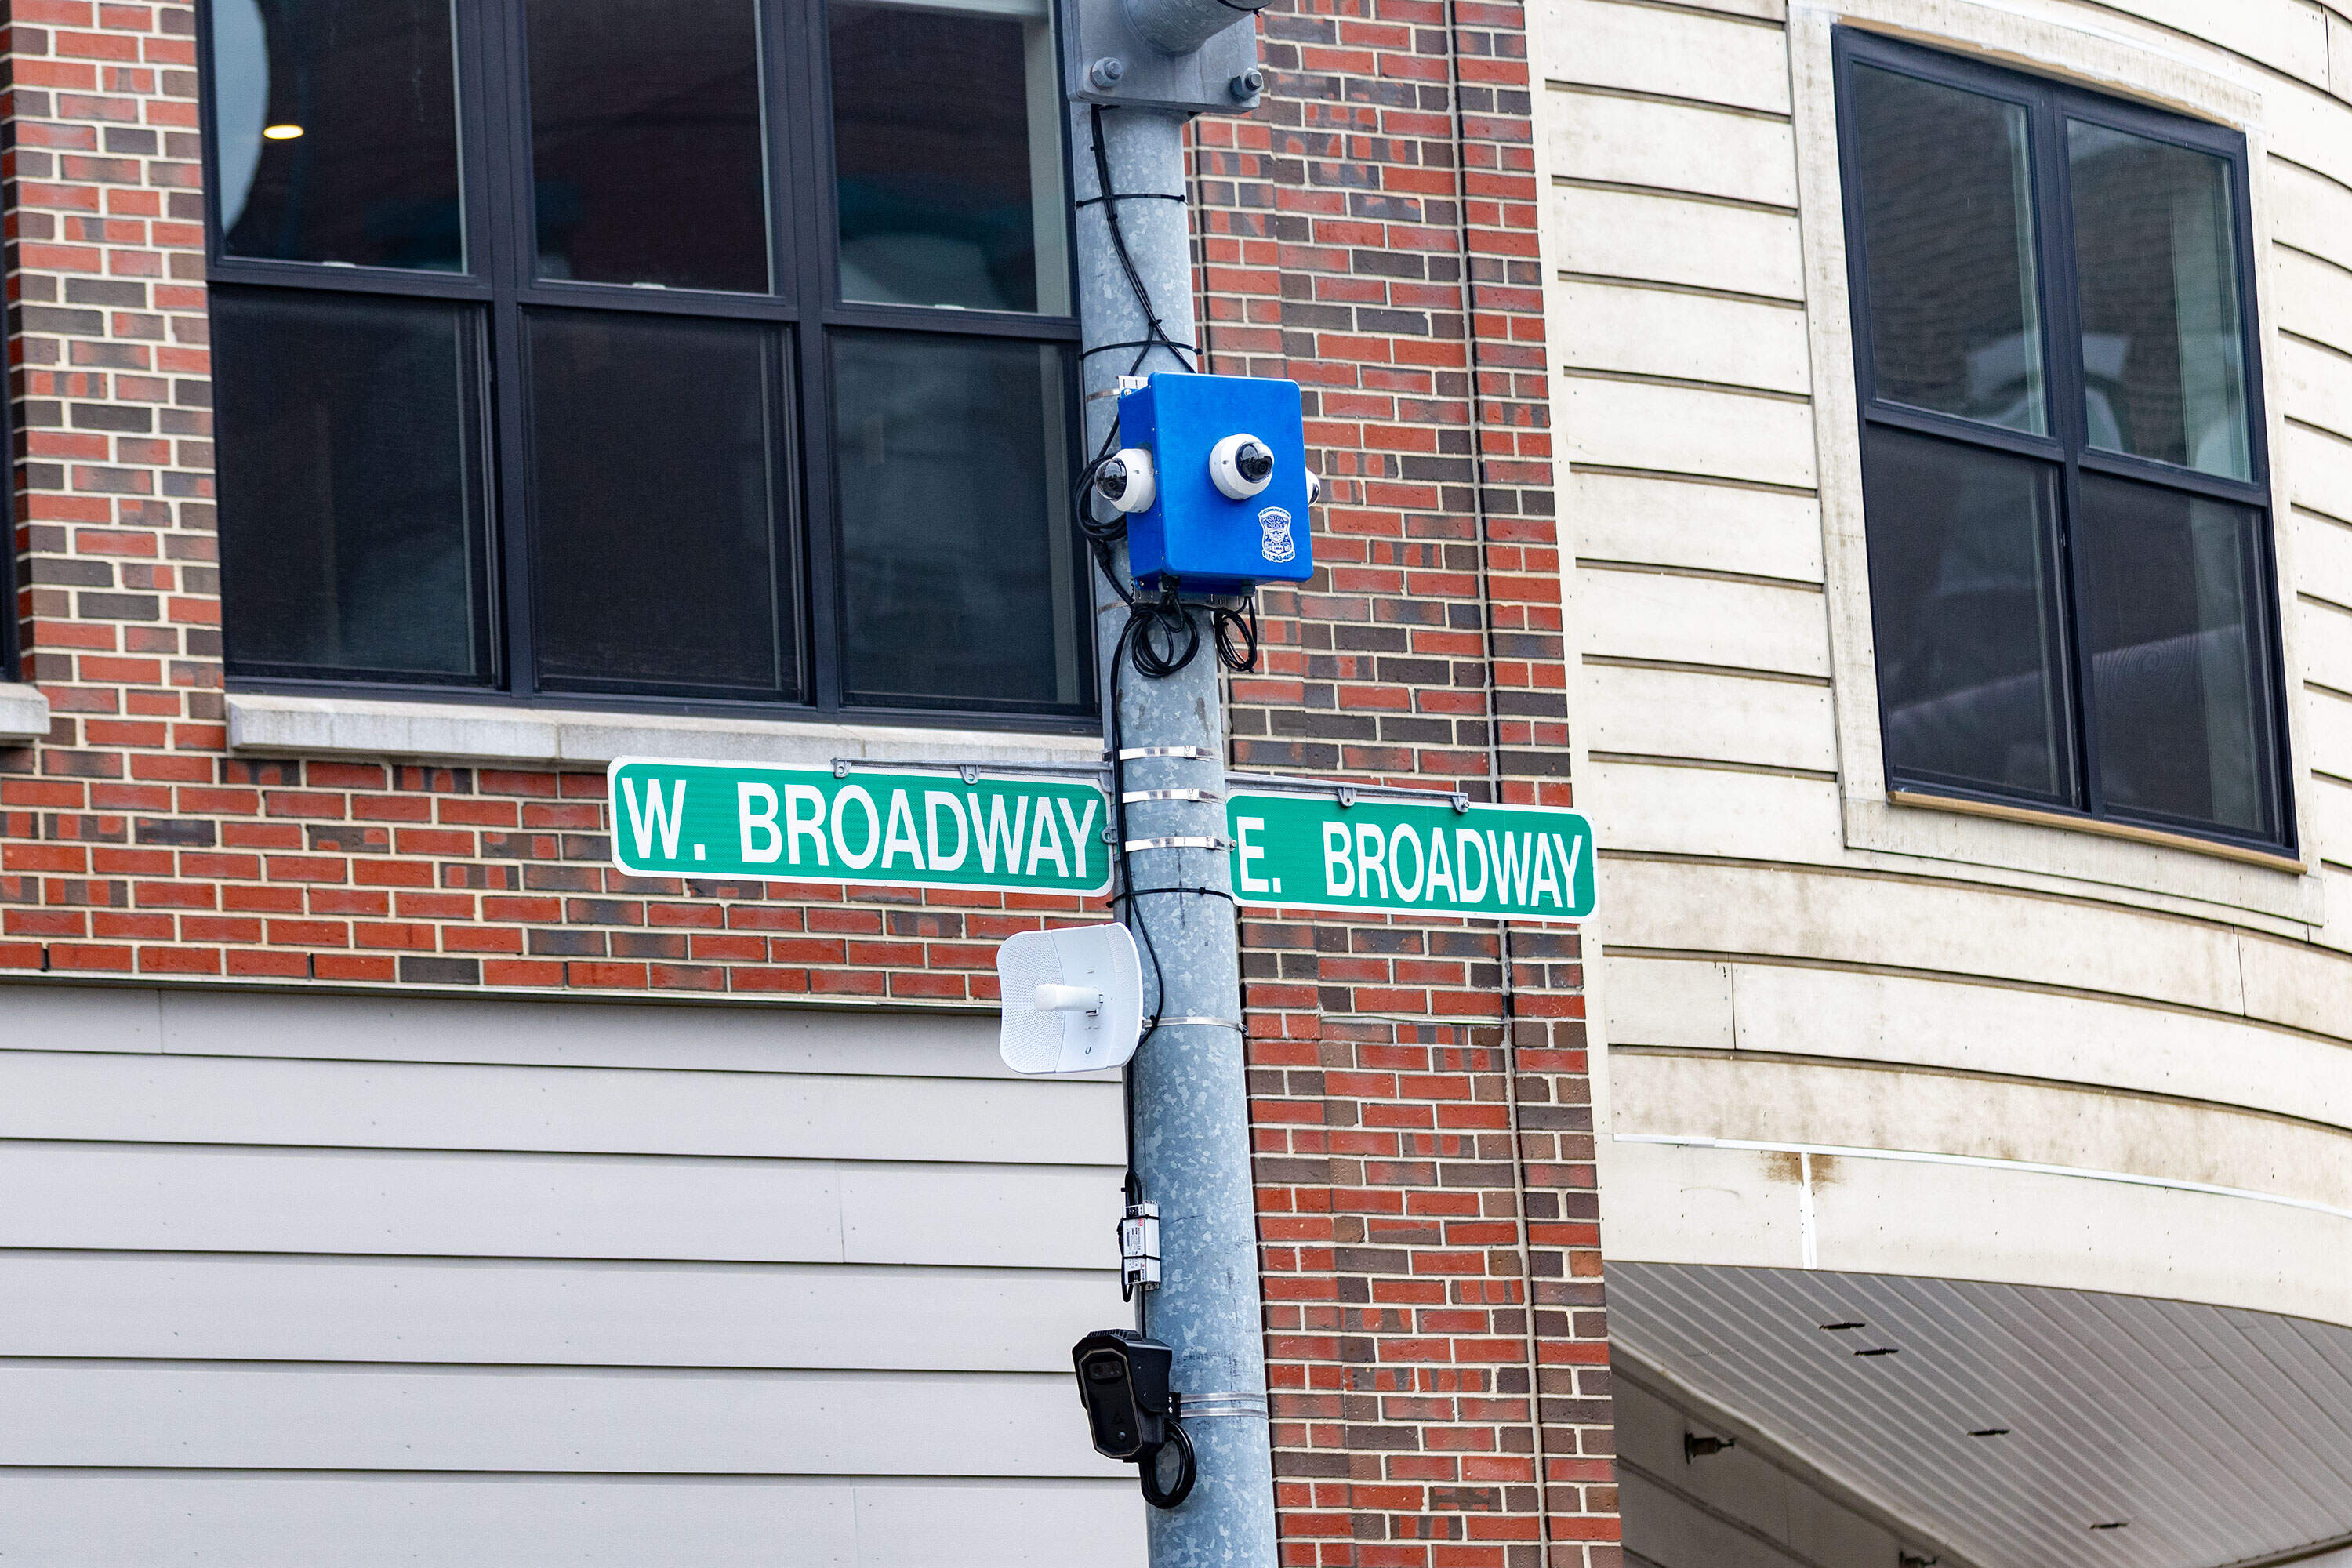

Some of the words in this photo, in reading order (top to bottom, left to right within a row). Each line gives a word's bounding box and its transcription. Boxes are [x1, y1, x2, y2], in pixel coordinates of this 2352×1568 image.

[621, 777, 706, 861] W.
[737, 782, 1098, 878] BROADWAY
[1236, 816, 1282, 894] E.
[1322, 821, 1583, 909] BROADWAY
